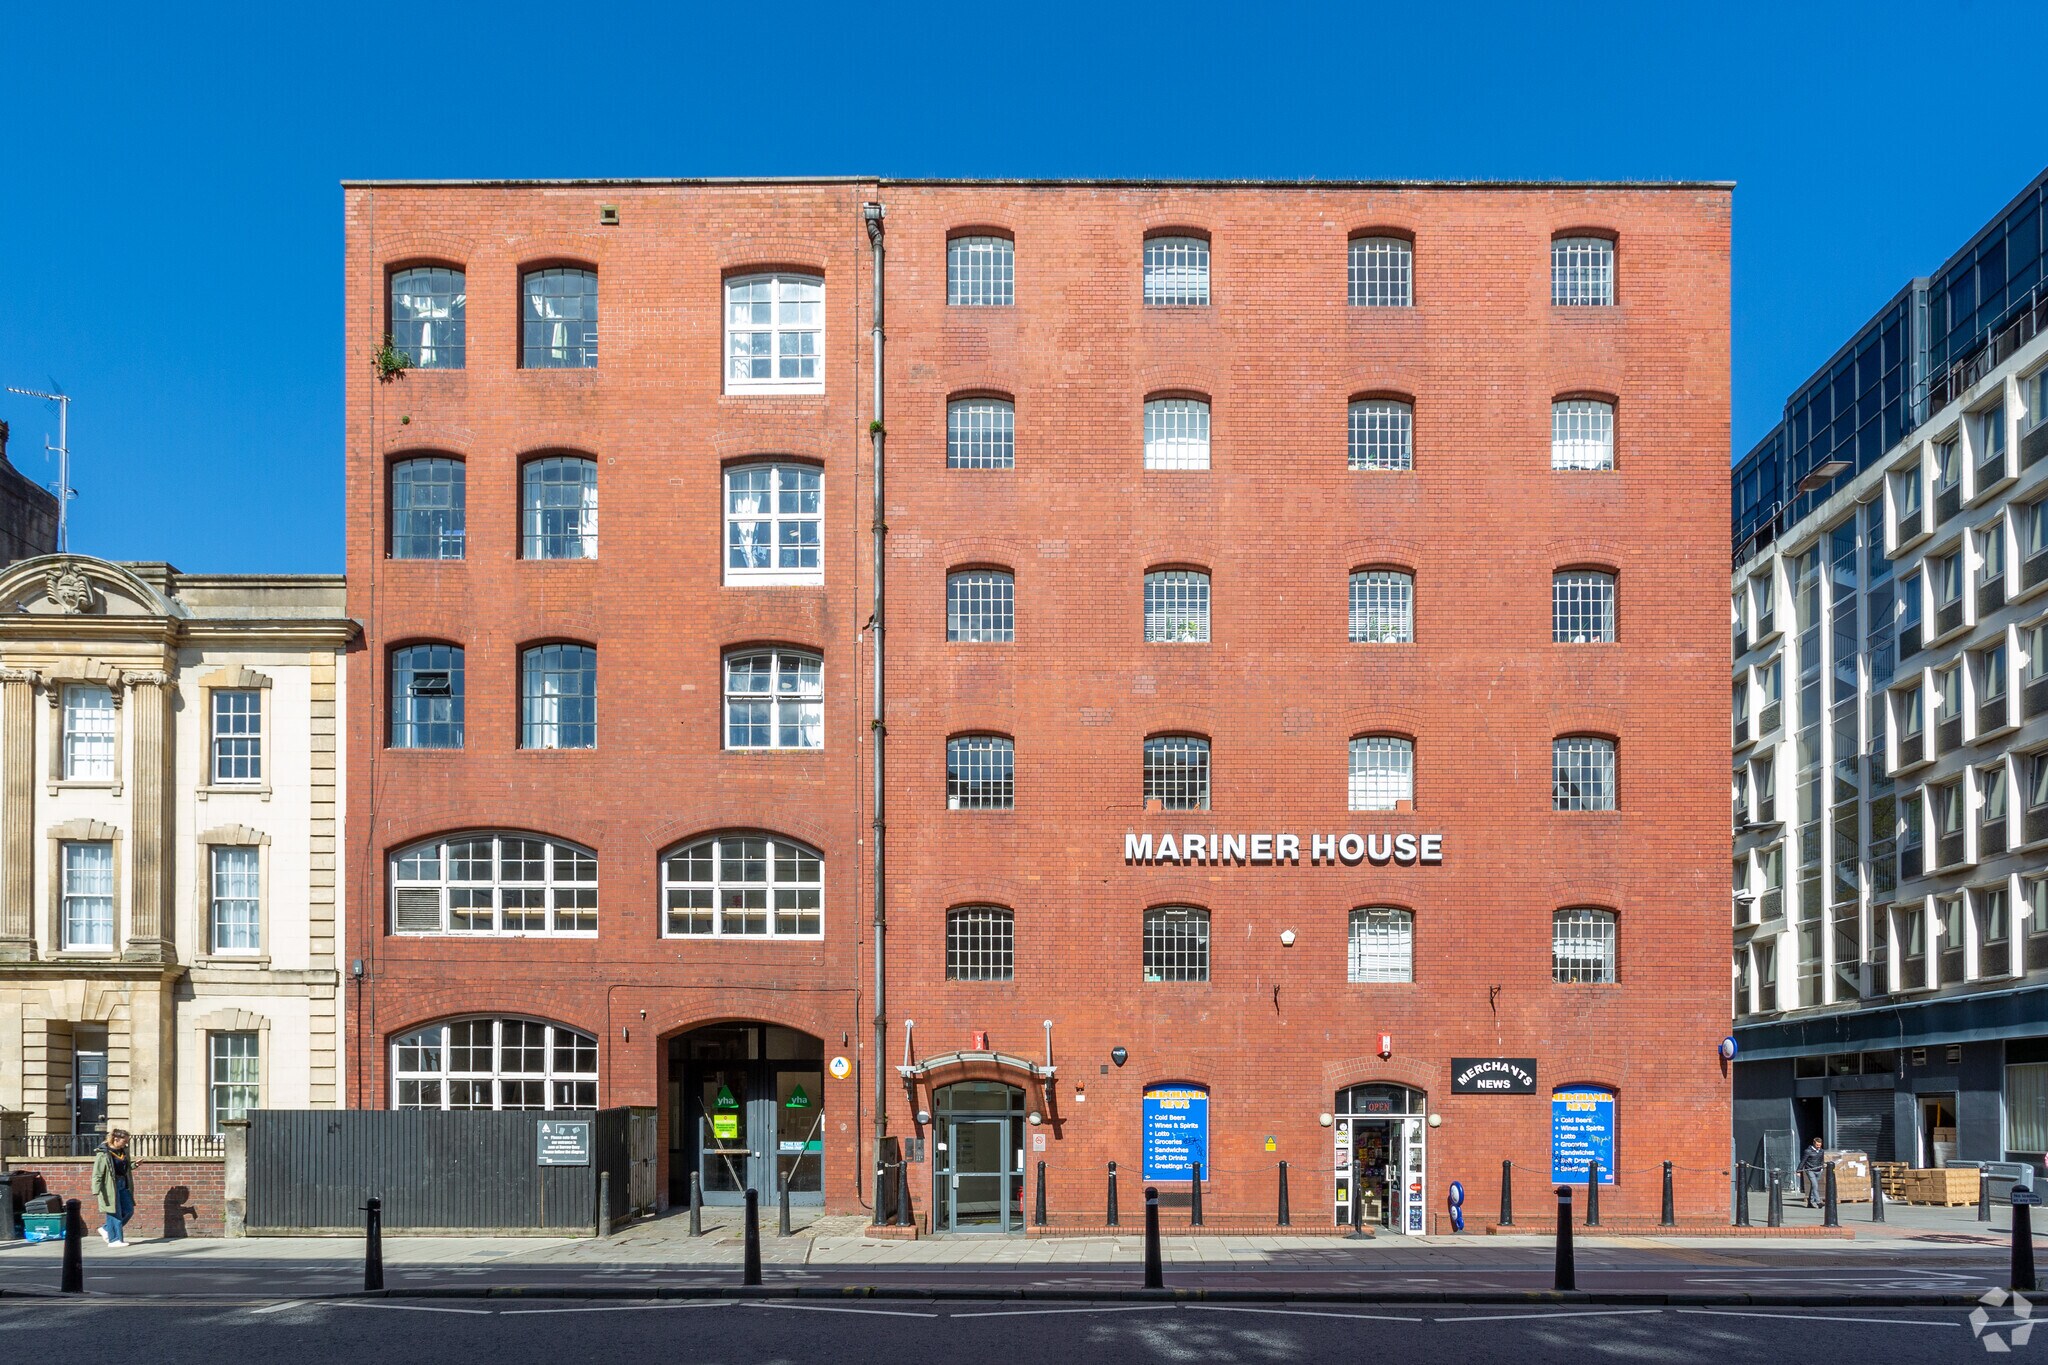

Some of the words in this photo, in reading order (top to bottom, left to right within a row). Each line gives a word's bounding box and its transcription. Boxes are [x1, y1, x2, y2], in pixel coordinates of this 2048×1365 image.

[1125, 834, 1299, 863] MARINER
[1312, 834, 1443, 863] HOUSE
[1457, 1062, 1533, 1086] MERCHANTS
[1477, 1080, 1511, 1089] NEWS
[1144, 1090, 1207, 1100] MERCHANTS
[1552, 1093, 1613, 1103] MERCHANTS
[717, 1097, 734, 1106] yha
[791, 1096, 808, 1105] yha
[1160, 1100, 1190, 1109] NEWS
[1368, 1103, 1390, 1112] OPEN
[1566, 1102, 1597, 1111] NEWS
